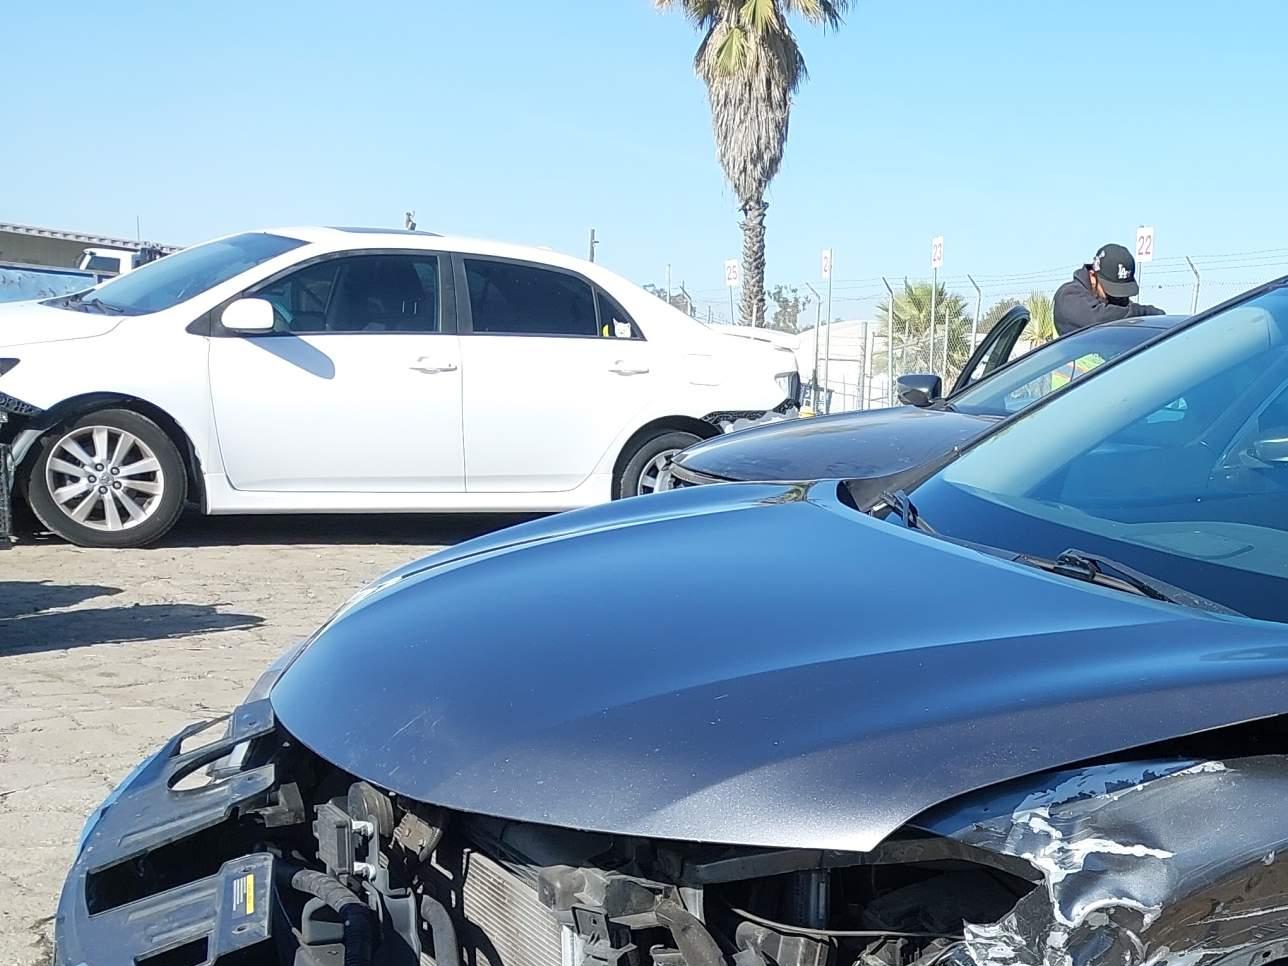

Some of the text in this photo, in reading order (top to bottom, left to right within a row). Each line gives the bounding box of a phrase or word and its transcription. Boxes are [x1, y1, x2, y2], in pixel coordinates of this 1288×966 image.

[933, 243, 942, 261] 23
[1138, 235, 1152, 255] 22
[726, 265, 737, 280] 25
